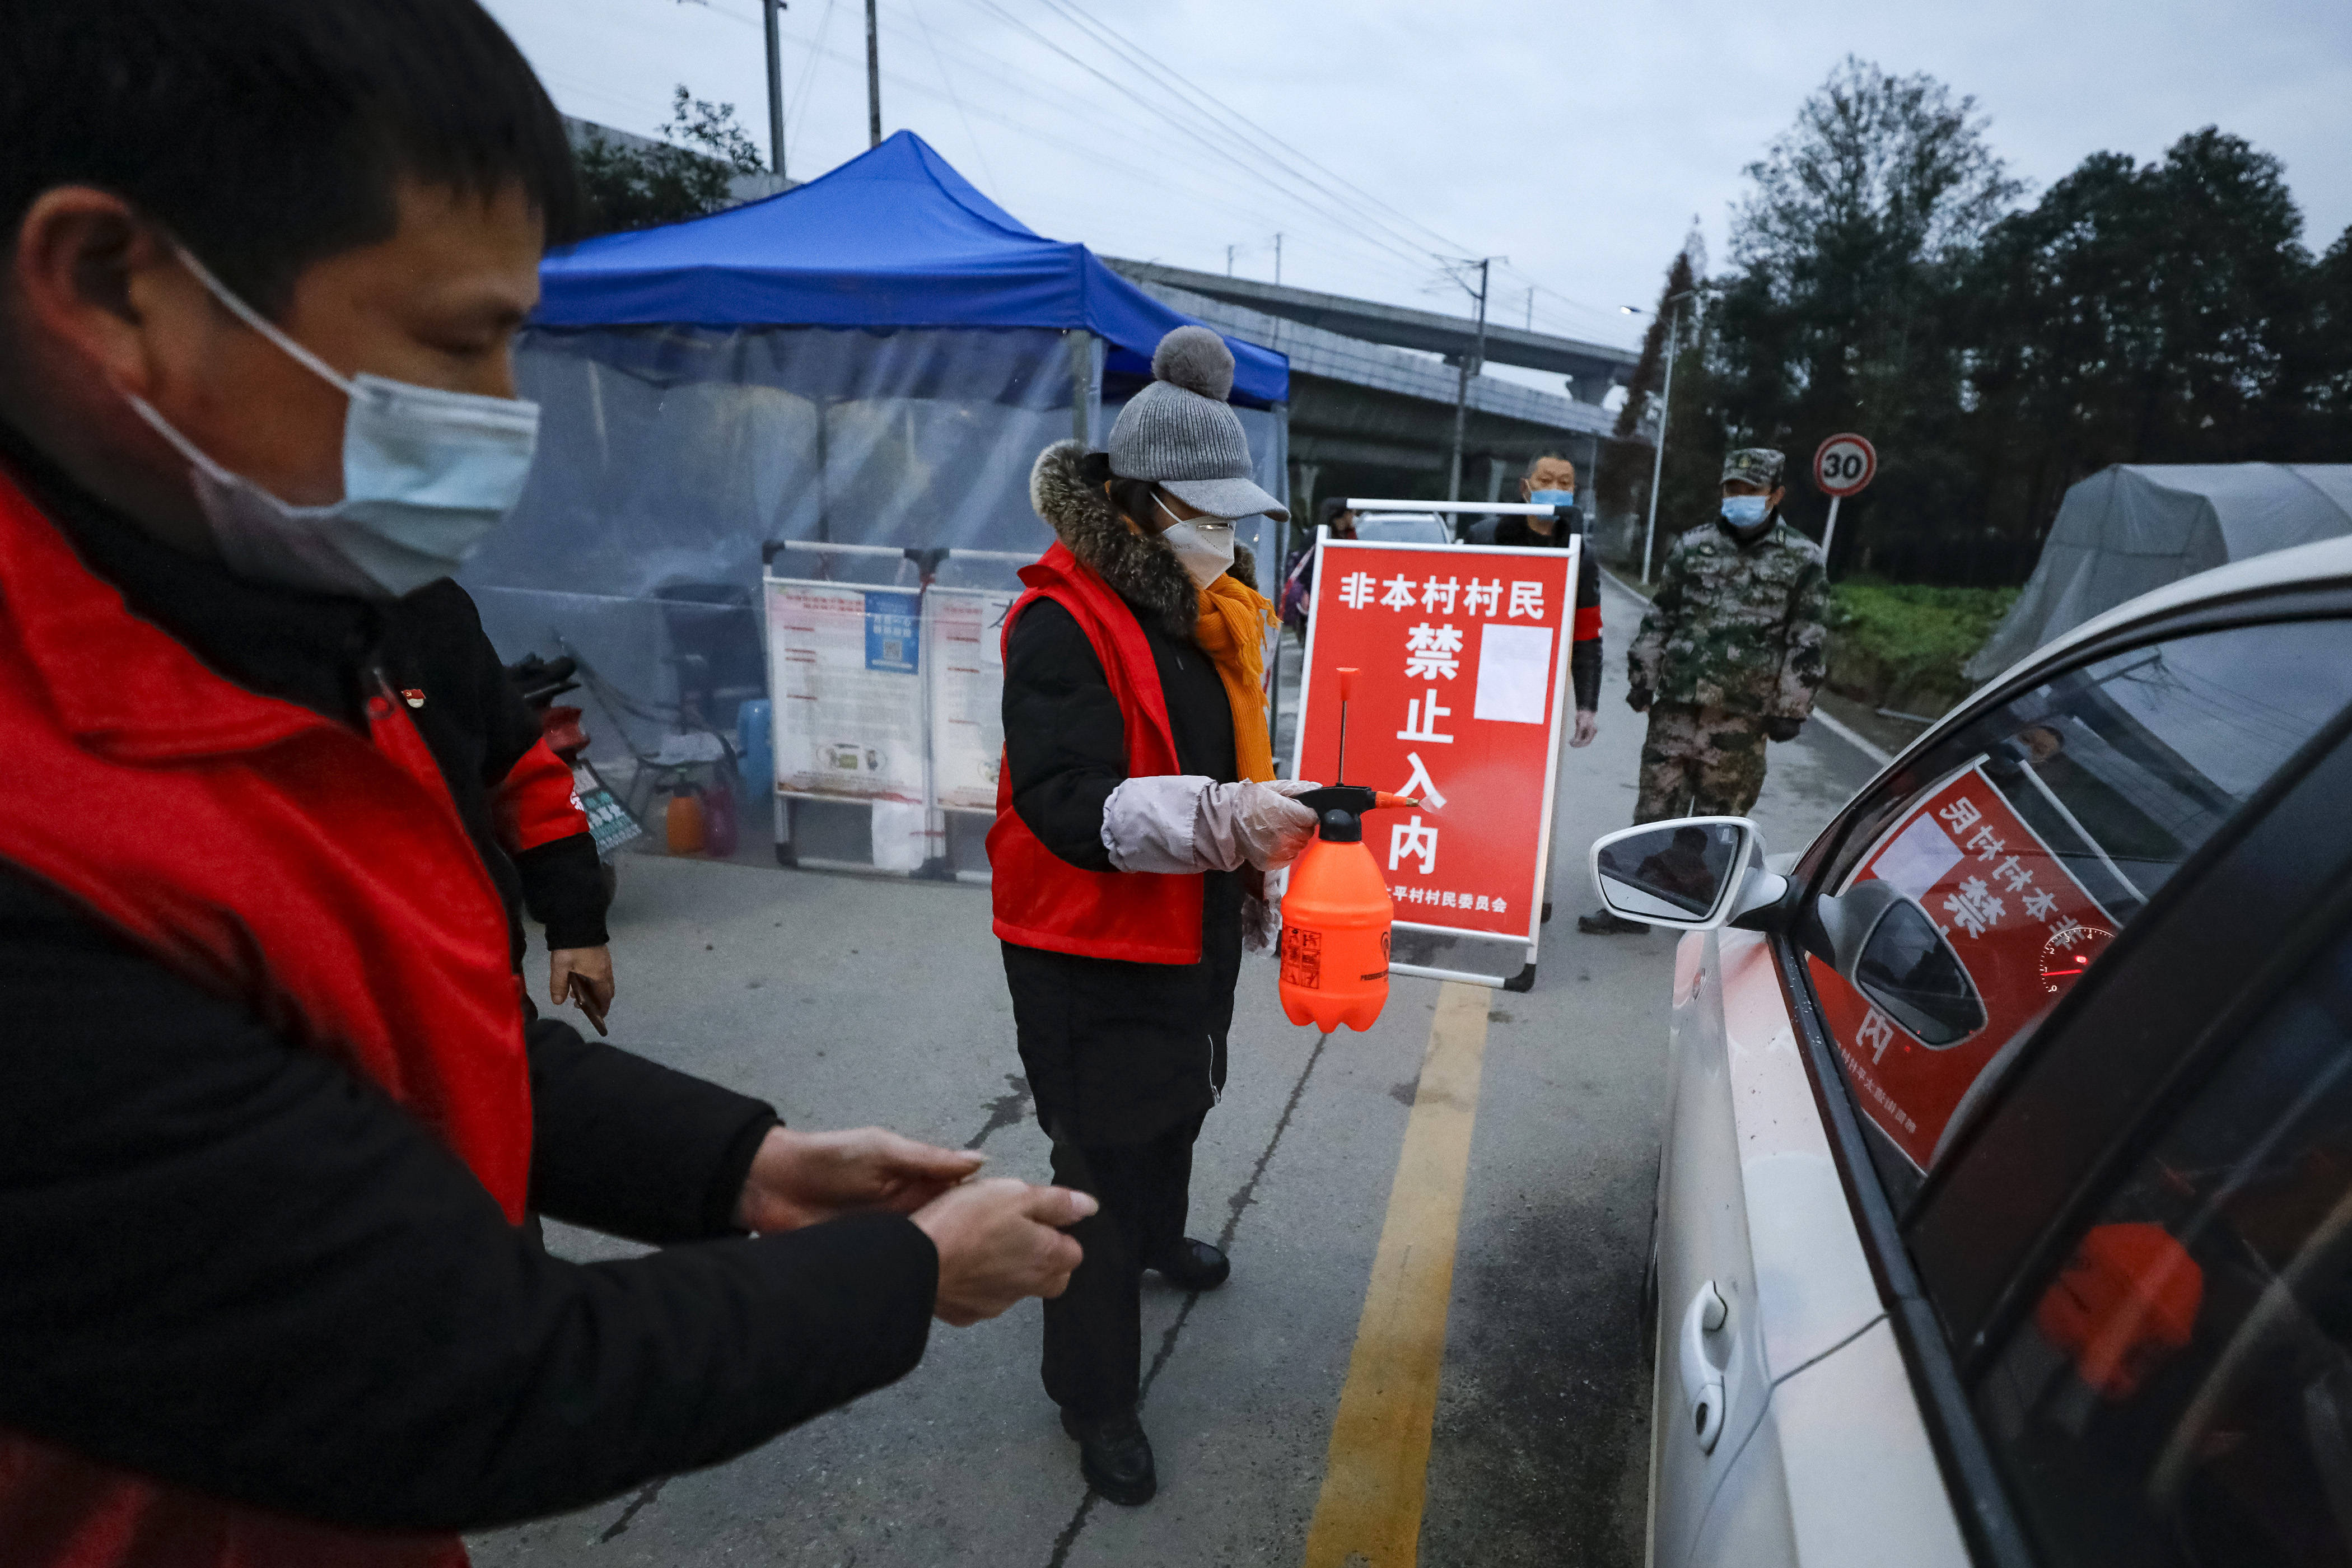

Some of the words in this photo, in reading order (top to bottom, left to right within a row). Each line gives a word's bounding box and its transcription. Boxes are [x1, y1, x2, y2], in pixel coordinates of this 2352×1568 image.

[1824, 454, 1861, 478] 30
[1338, 571, 1544, 619] 非本村村民
[1388, 622, 1463, 874] 禁止入内
[1386, 885, 1508, 913] 平村村民委员会
